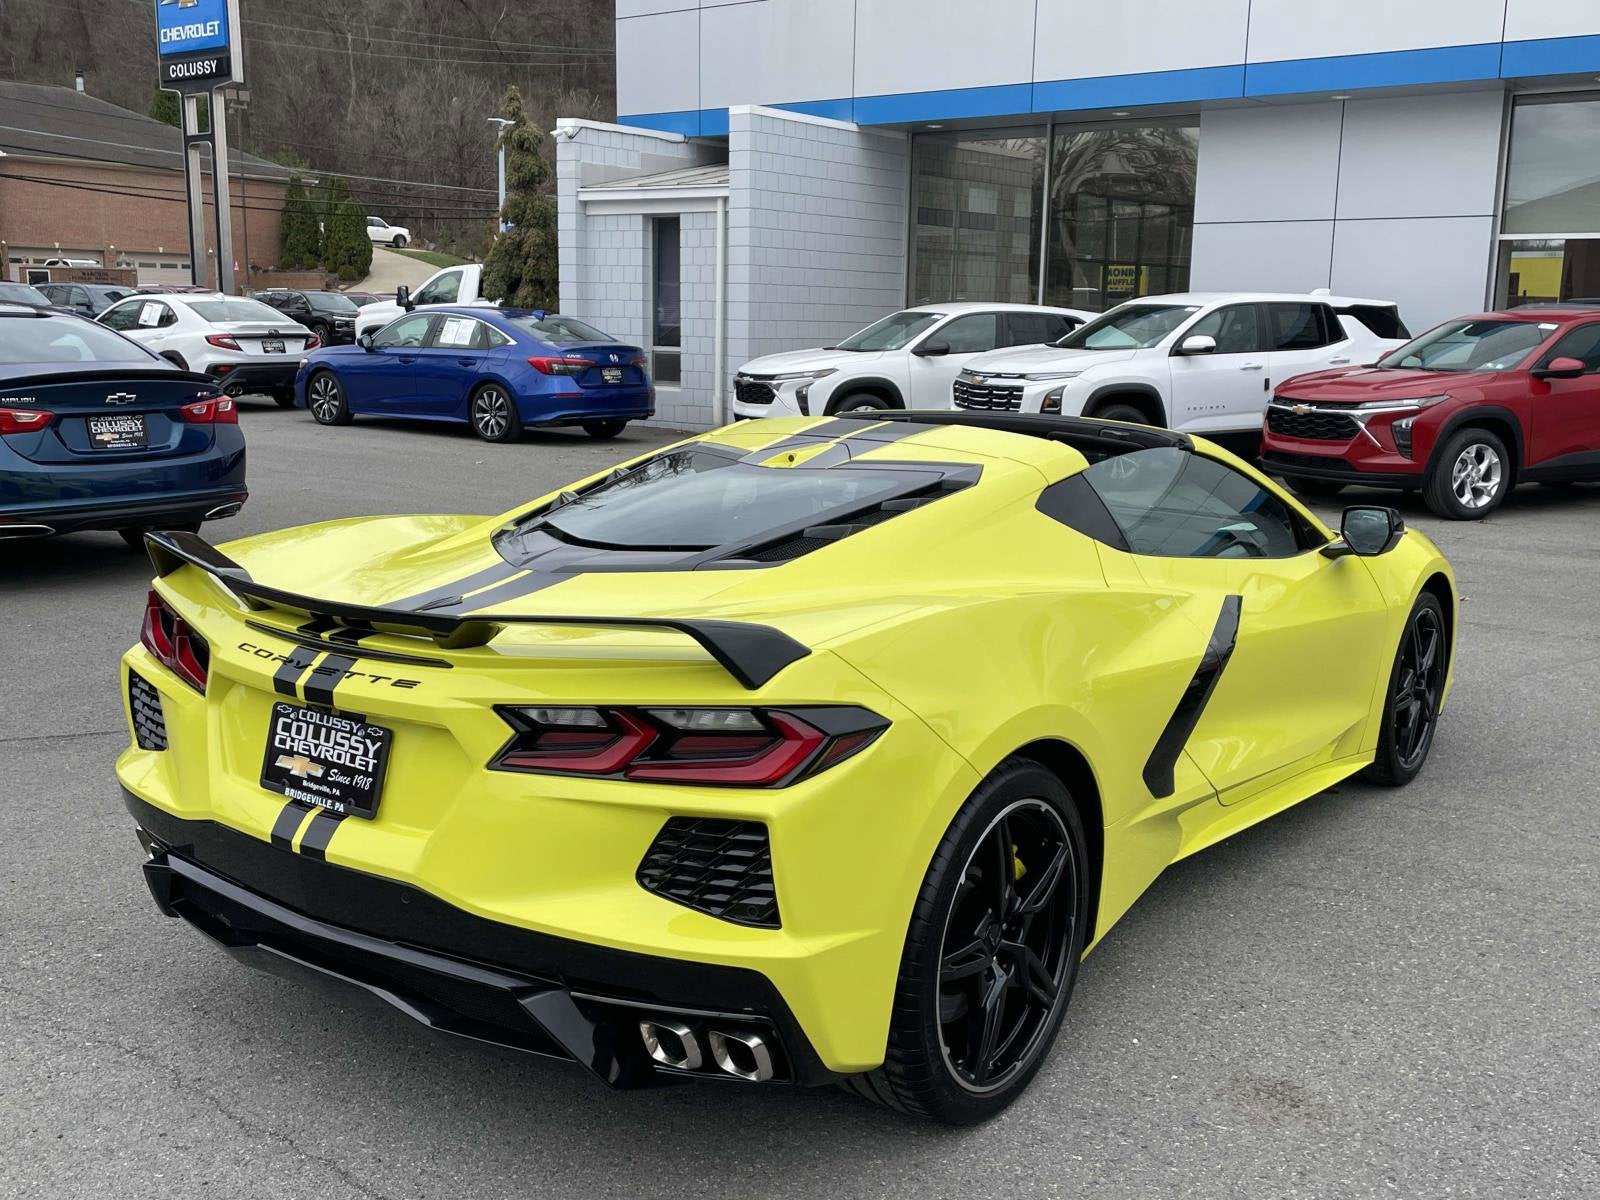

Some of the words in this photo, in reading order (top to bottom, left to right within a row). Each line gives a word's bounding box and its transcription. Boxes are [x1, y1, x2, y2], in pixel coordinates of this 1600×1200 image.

[160, 20, 220, 43] CHEVROLET
[169, 60, 217, 78] COLUSSY
[1, 396, 36, 404] MALIBU
[91, 419, 143, 430] COLUSSY
[91, 425, 144, 434] CHEVROLET
[237, 642, 422, 689] CORVETTE
[298, 709, 361, 734] COLUSSY
[276, 717, 382, 759] COLUSSY
[274, 734, 378, 772] CHEVROLET
[302, 779, 331, 795] Bridgeville,
[331, 787, 340, 796] PA
[327, 768, 351, 785] Since
[352, 774, 373, 790] 1918
[334, 802, 345, 813] PA
